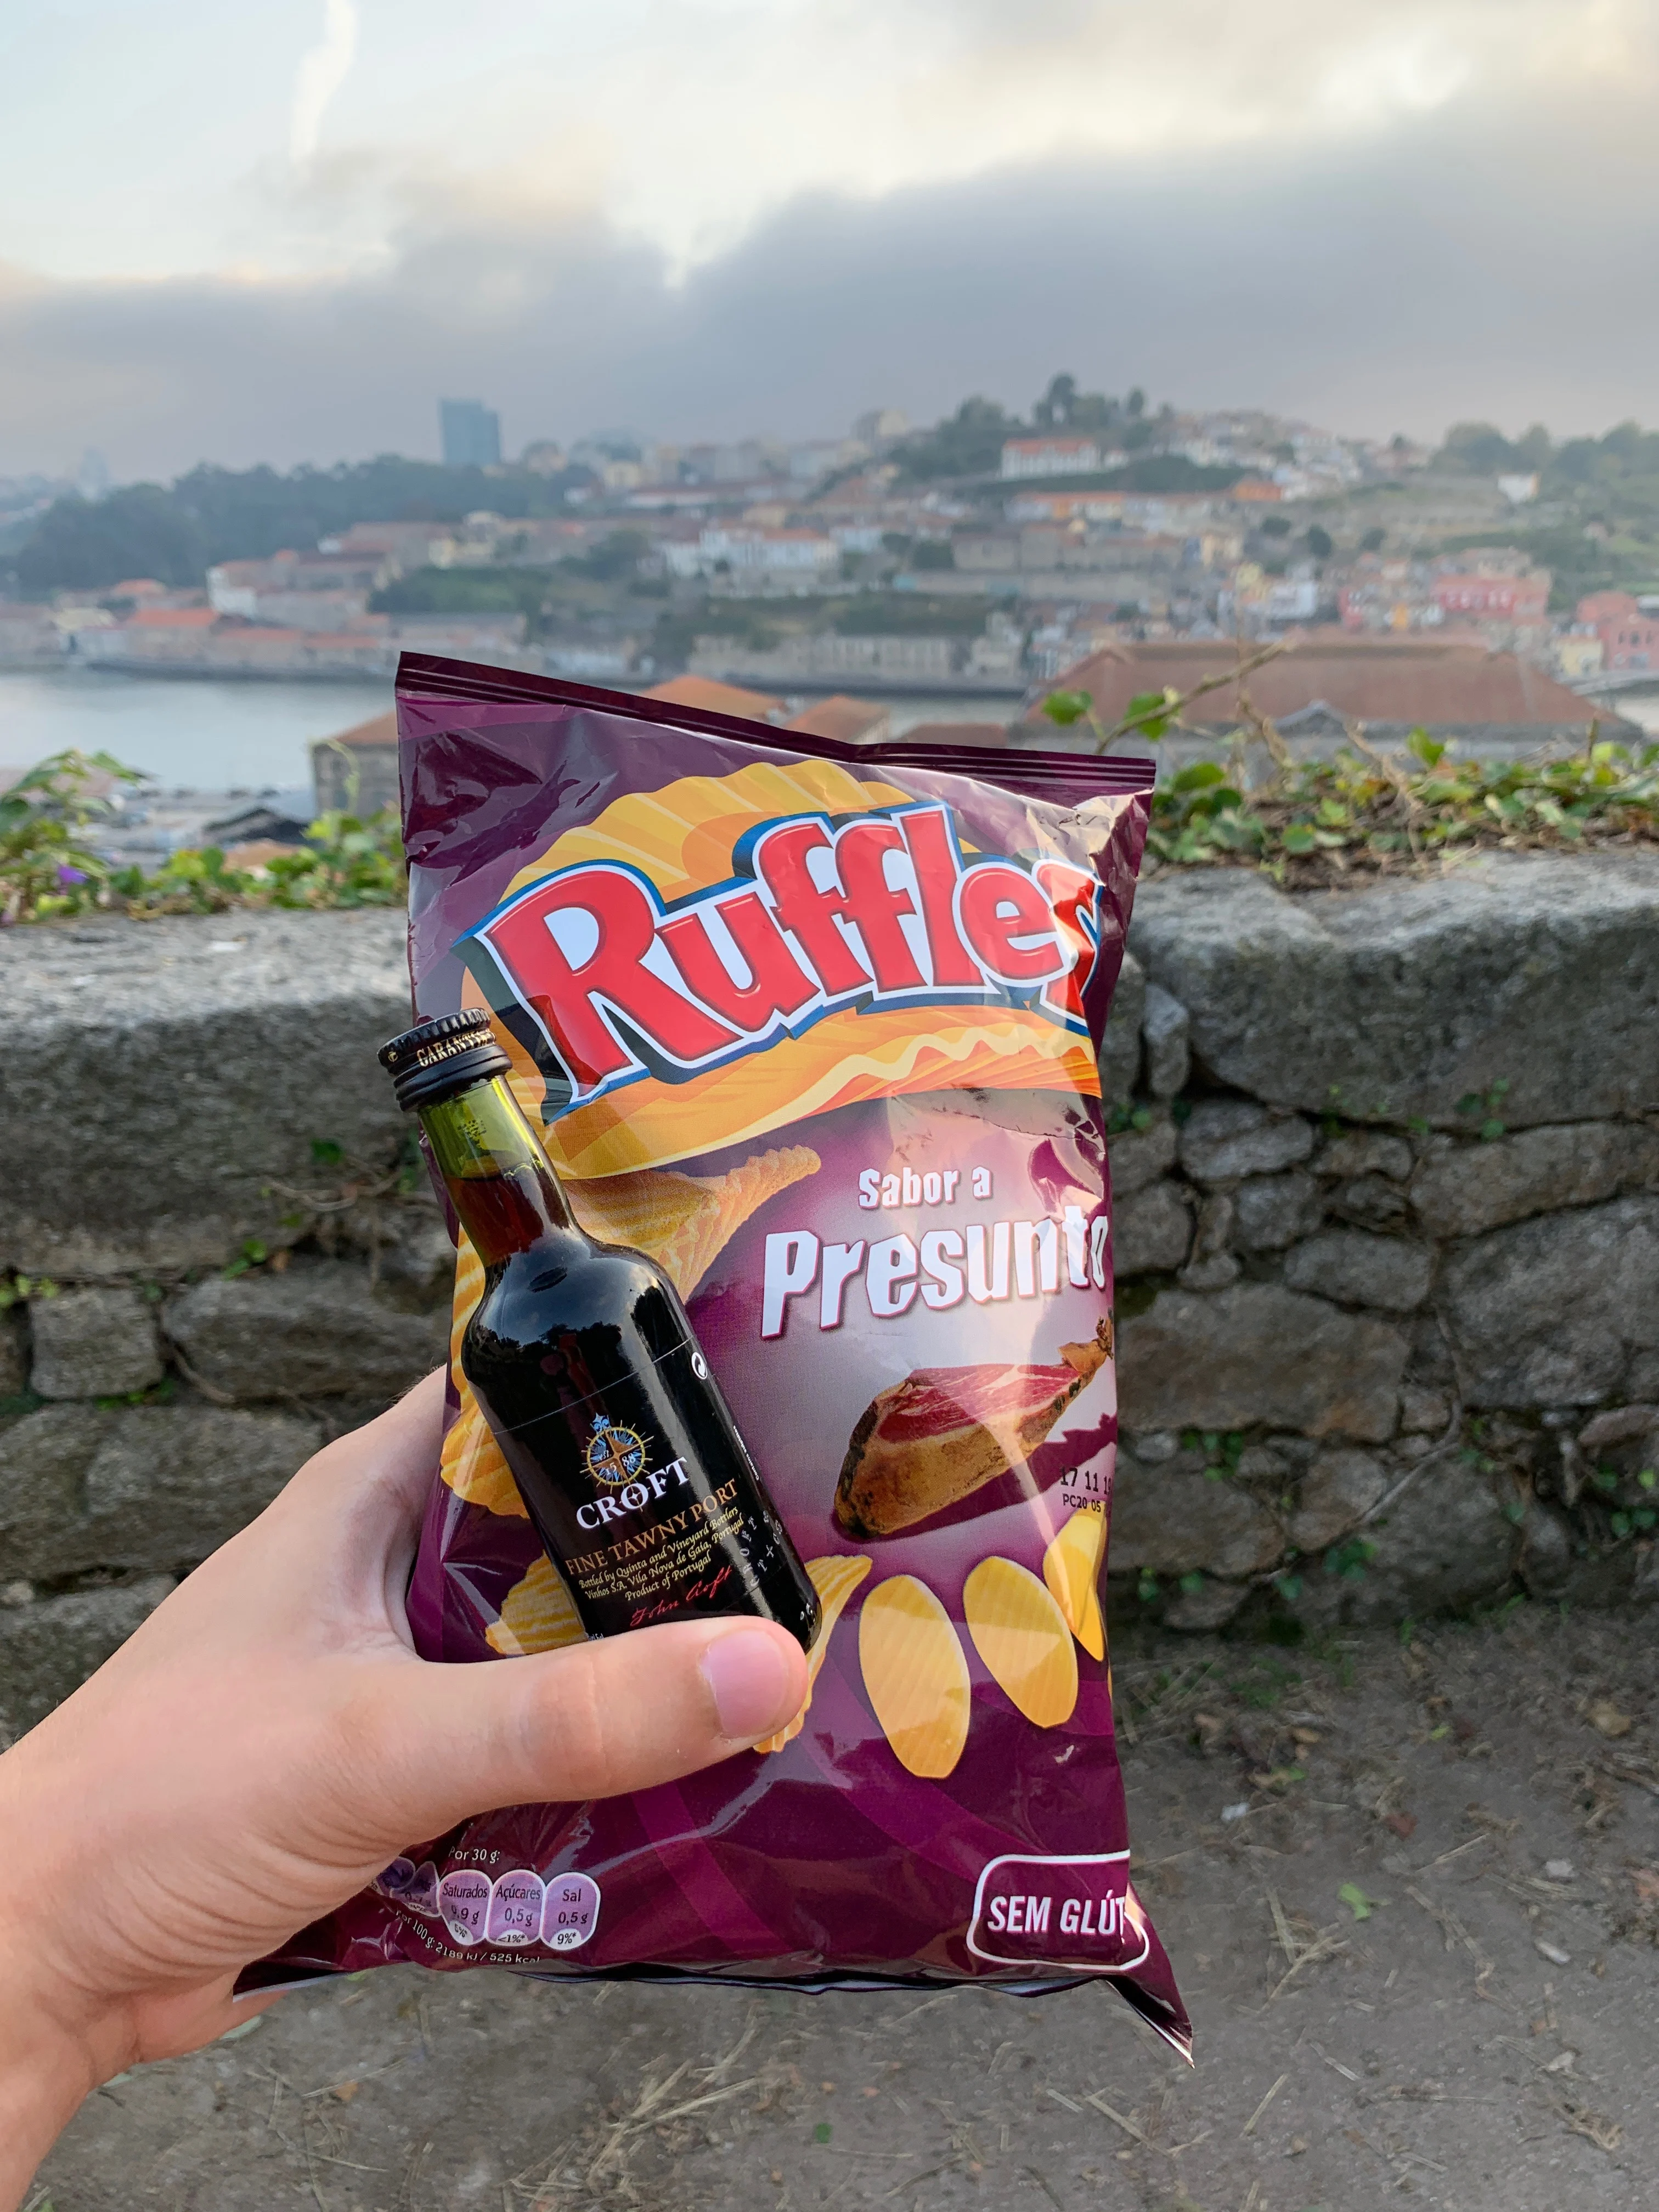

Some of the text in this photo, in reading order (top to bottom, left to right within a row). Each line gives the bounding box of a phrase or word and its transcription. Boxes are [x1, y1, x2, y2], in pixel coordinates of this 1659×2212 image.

[473, 801, 1102, 1101] Ruffles
[859, 1166, 992, 1208] Sabor a
[761, 1206, 1108, 1340] Presunto
[576, 1457, 689, 1529] CROFT
[1059, 1466, 1077, 1487] 17
[1085, 1470, 1098, 1492] 11
[1062, 1493, 1101, 1513] PC20 05
[565, 1479, 738, 1576] FINE TAWNY PORT
[578, 1506, 738, 1589] Bottled by Quinta and Vineyard Bottlers
[585, 1585, 610, 1600] Vinhos
[628, 1570, 648, 1587] Vila
[648, 1560, 674, 1578] Nova
[676, 1550, 686, 1565] de
[687, 1541, 712, 1561] Gaia,
[711, 1512, 744, 1544] Portugal
[625, 1549, 712, 1601] Product of Portugal
[448, 1846, 500, 1864] Por 30 g:
[443, 1883, 488, 1900] Saturados
[495, 1883, 541, 1901] Açúcares
[562, 1888, 582, 1902] Sal
[471, 1910, 479, 1925] g
[504, 1907, 533, 1927] 0,5 g
[558, 1911, 588, 1925] 0,5 g
[987, 1895, 1053, 1933] SEM
[412, 1919, 428, 1940] 100
[425, 1937, 435, 1948] g:
[435, 1942, 464, 1960] 2189
[466, 1952, 478, 1961] kJ
[479, 1951, 488, 1961] /
[489, 1953, 512, 1963] 525
[515, 1953, 540, 1964] kcal
